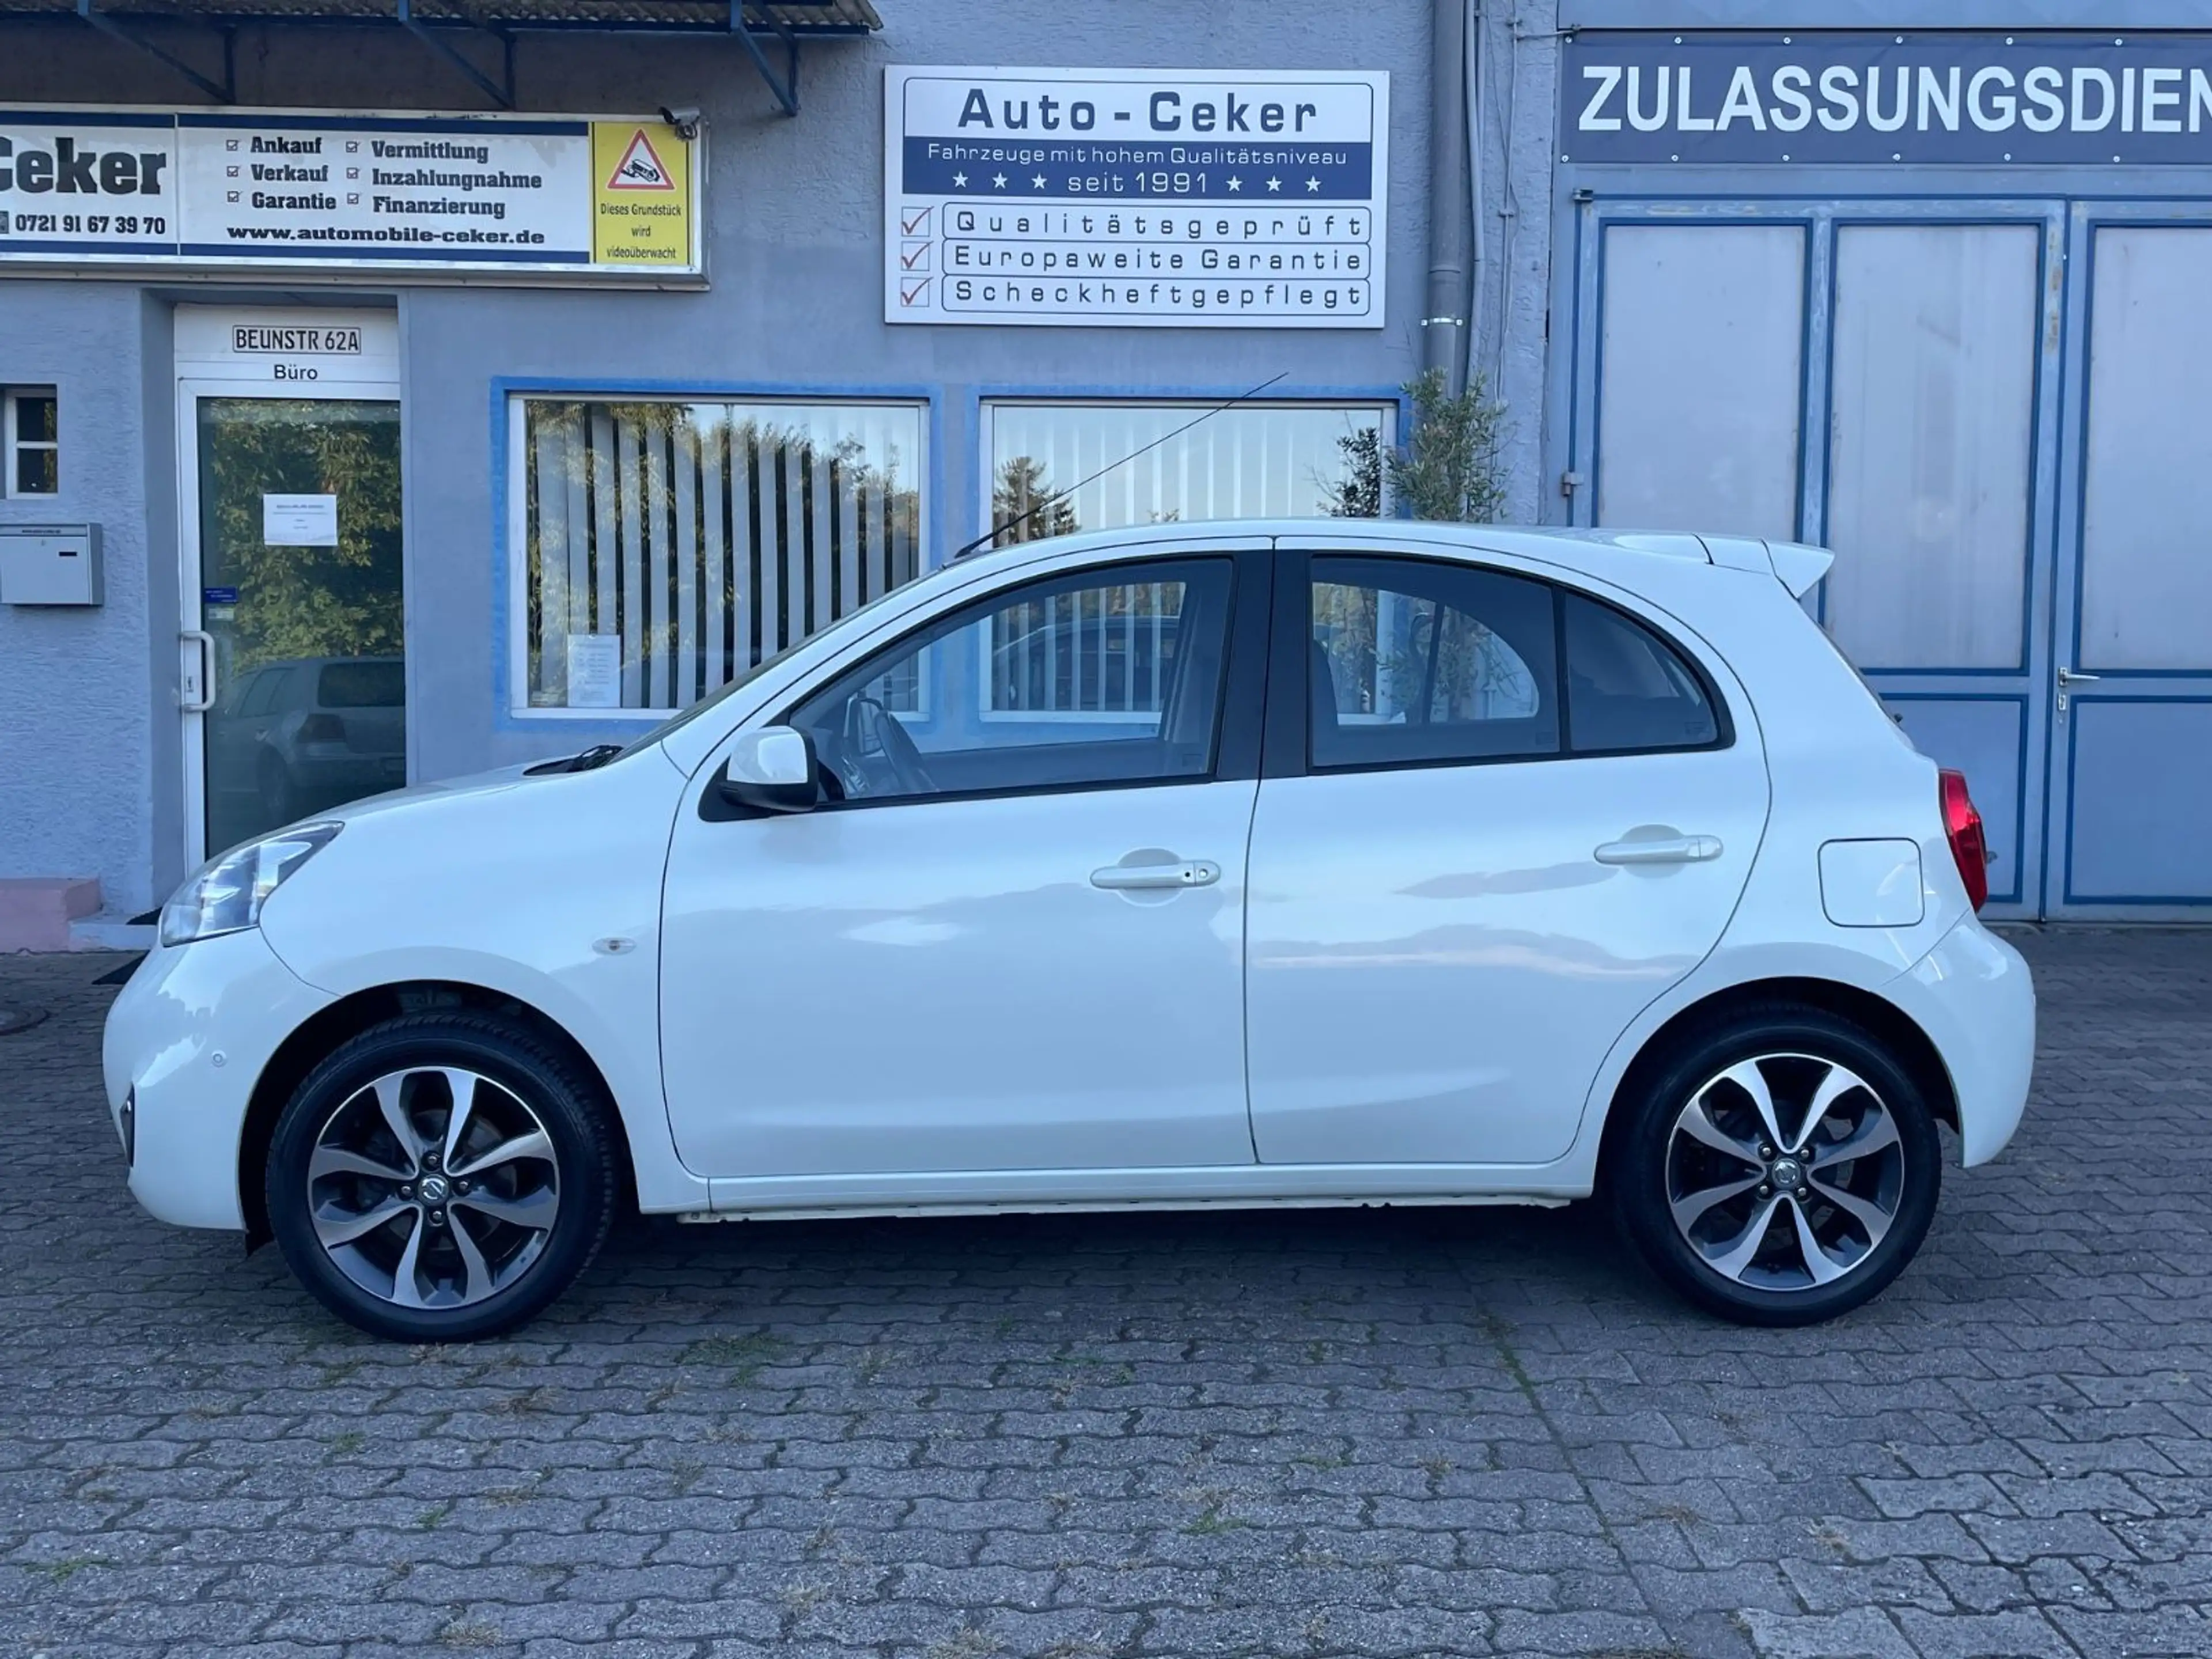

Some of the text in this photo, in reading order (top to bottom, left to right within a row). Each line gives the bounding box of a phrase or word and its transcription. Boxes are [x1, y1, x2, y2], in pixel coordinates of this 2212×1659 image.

[251, 136, 322, 154] Ankauf
[371, 140, 489, 164] Vermittlung
[929, 143, 1346, 165] Fahrzeuge mit hohem Qualitätsniveau
[251, 164, 328, 182] Verkauf
[372, 168, 542, 192] Inzahlungnahme
[1068, 172, 1206, 193] seit 1991
[252, 191, 336, 210] Garantie
[373, 196, 506, 219] Finanzierung
[600, 202, 681, 216] Dieses Grundstück
[16, 214, 165, 234] 0721 91 67 39 70
[631, 225, 651, 237] wird
[956, 210, 1361, 239] Qualitätsgeprüft
[226, 227, 544, 244] www.automobile-ceker.de
[607, 246, 676, 259] videoüberwacht
[955, 245, 1360, 271] Europaweite Garantie
[956, 281, 1361, 308] Scheckheftgepflegt
[324, 331, 359, 351] 62A
[274, 364, 318, 380] Büro
